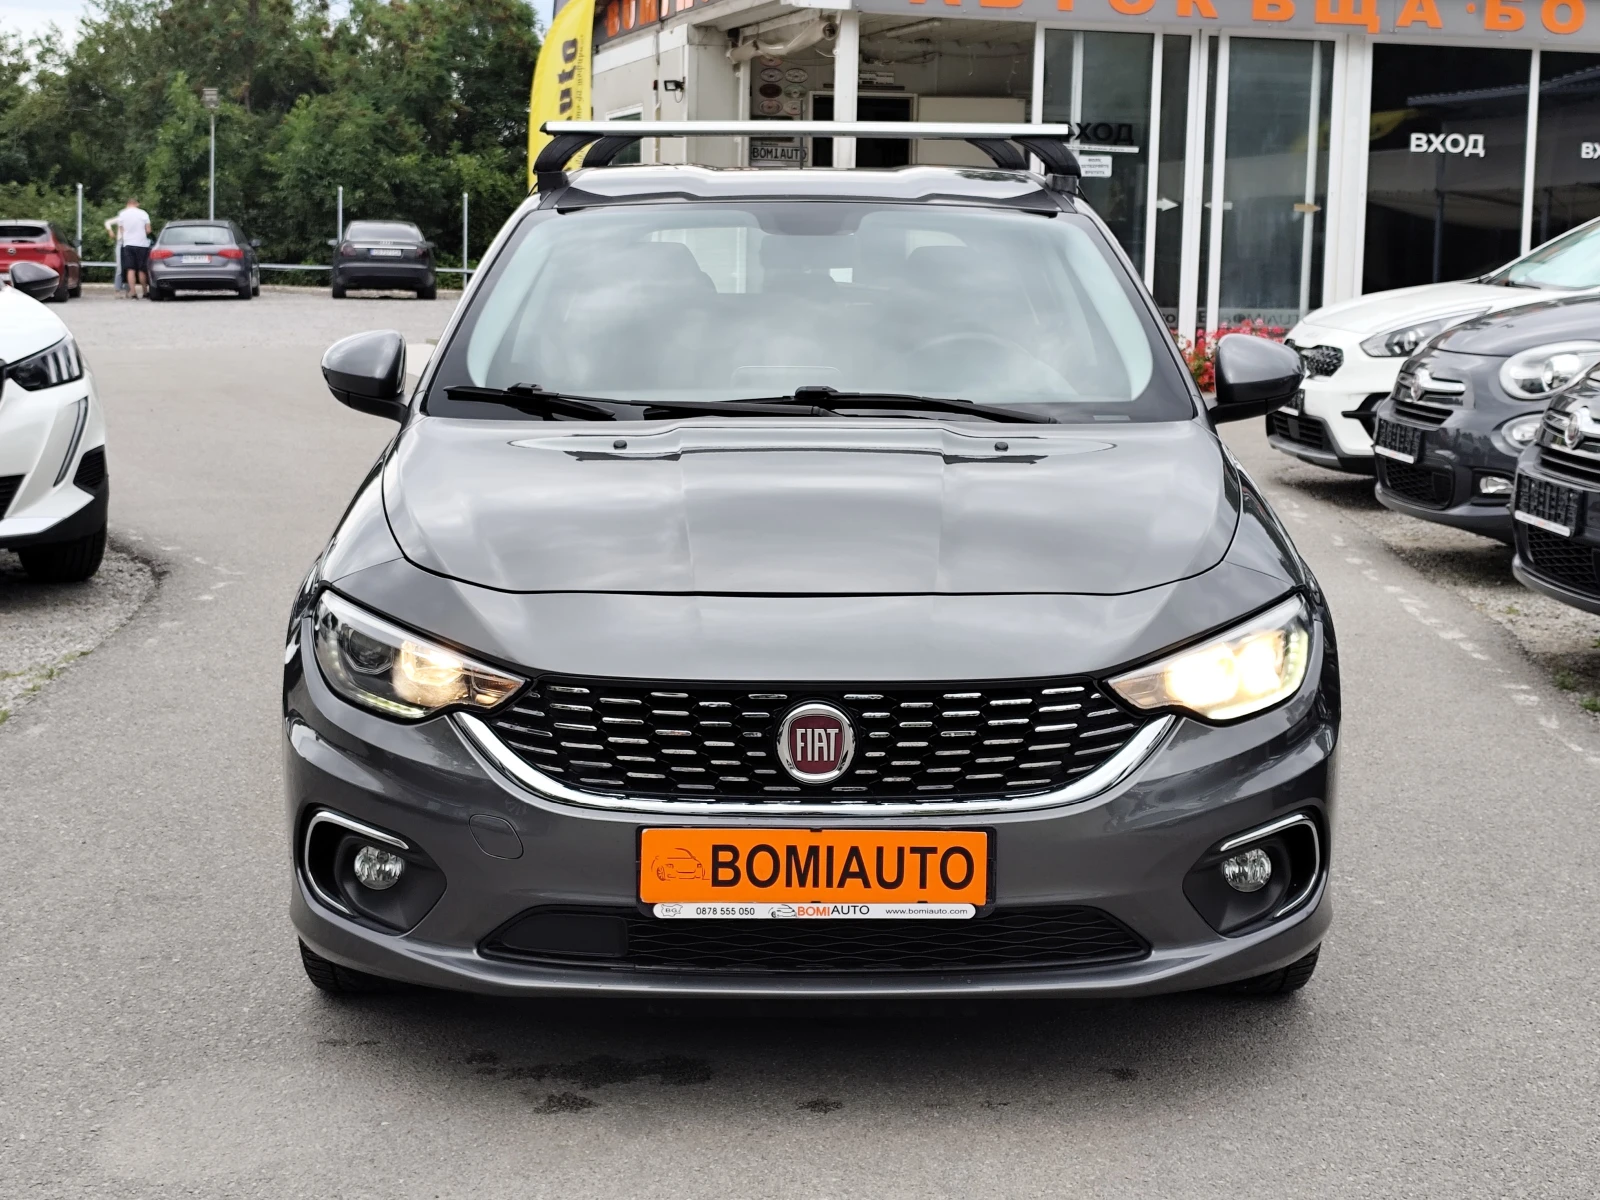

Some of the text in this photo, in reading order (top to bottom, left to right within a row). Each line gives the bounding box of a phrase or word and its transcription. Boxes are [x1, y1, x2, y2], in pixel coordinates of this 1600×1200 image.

[909, 0, 1443, 34] КЪЩА
[1074, 122, 1134, 145] ХОД
[1410, 132, 1486, 158] ВХОД
[796, 728, 839, 762] FIAT
[711, 843, 975, 891] BOMIAUTO
[696, 906, 718, 916] 0878
[720, 906, 736, 916] 555
[738, 906, 755, 916] 050
[797, 904, 870, 917] BOMIAUTO
[885, 907, 967, 916] www.bomiauto.com
